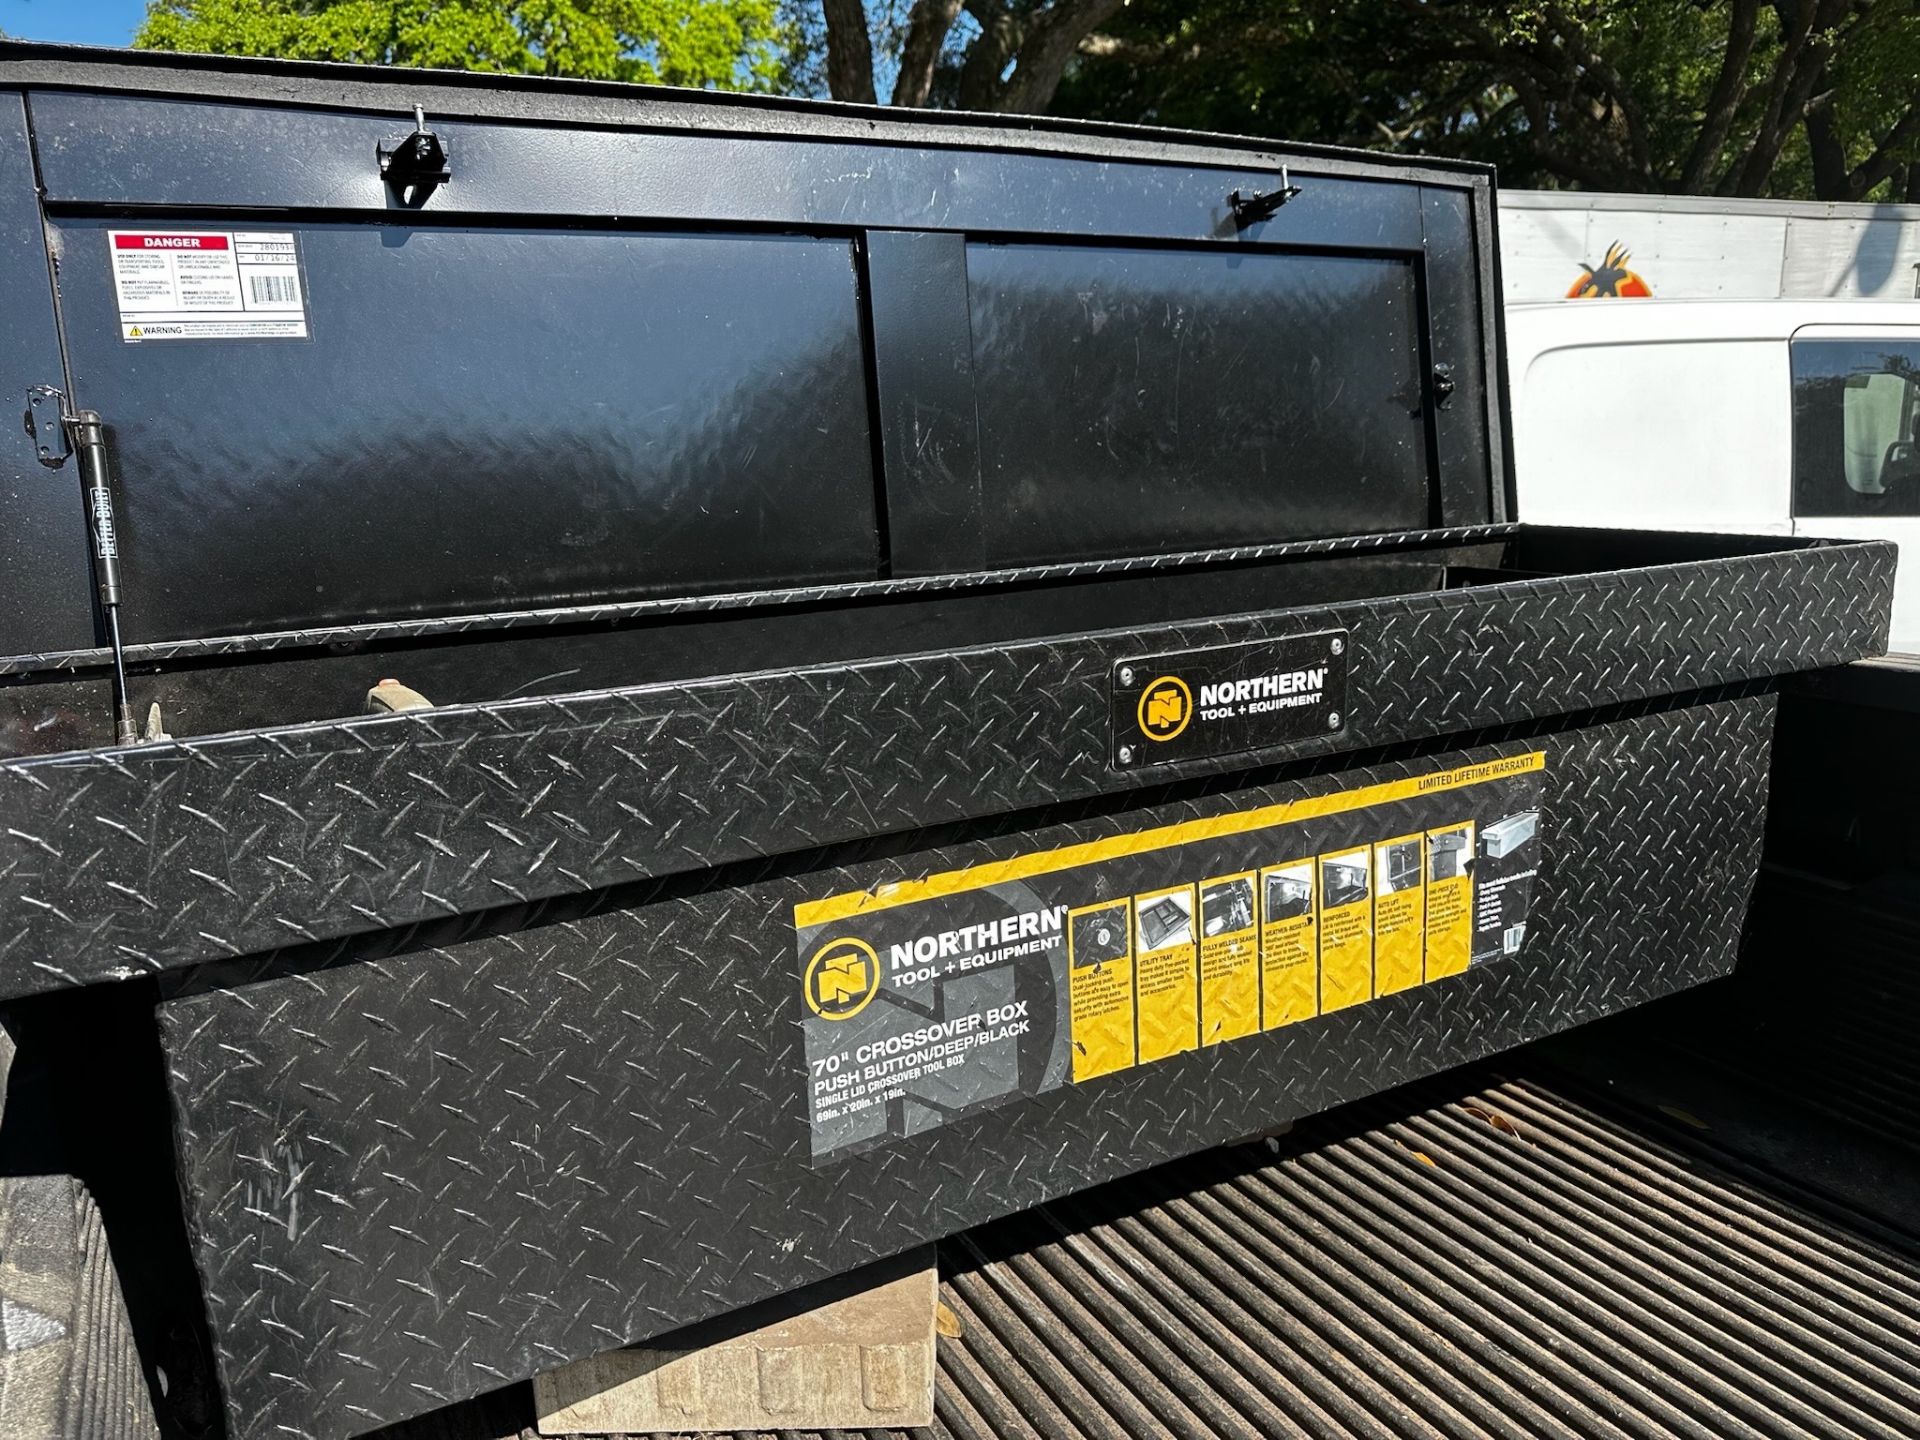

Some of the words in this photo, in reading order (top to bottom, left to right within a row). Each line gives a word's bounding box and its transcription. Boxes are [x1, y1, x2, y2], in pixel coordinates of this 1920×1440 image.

[144, 238, 200, 248] DANGER
[254, 254, 295, 262] 01/16/24
[143, 326, 182, 334] WARNING
[94, 490, 110, 518] BUILT
[98, 520, 115, 555] BETTER
[1200, 669, 1325, 706] NORTHERN
[1200, 707, 1235, 721] TOOL
[1249, 693, 1322, 714] EQUIPMENT
[1418, 775, 1452, 790] LIMITED
[1454, 766, 1490, 782] LIFETIME
[1492, 756, 1535, 773] WARRANTY
[891, 907, 1063, 970] NORTHERN
[892, 968, 940, 987] TOOL
[959, 935, 1063, 970] EQUIPMENT
[1072, 975, 1087, 983] PUSH
[1088, 968, 1112, 980] BUTTONS
[1140, 957, 1158, 967] UTILITY
[812, 1051, 849, 1077] 70"
[856, 1012, 985, 1063] CROSSOVER
[986, 1000, 1029, 1025] BOX
[814, 1073, 860, 1096] PUSH
[864, 1019, 1031, 1079] BUTTON/DEEP/BLACK
[815, 1090, 849, 1109] SINGLE
[851, 1083, 866, 1098] LID
[868, 1068, 921, 1093] CROSSOVER
[923, 1060, 945, 1076] TOOL
[946, 1053, 965, 1069] BOX
[816, 1107, 841, 1123] 69in.
[842, 1106, 849, 1115] x
[850, 1098, 874, 1113] 20in.
[874, 1096, 881, 1105] x
[882, 1088, 906, 1103] 19in.
